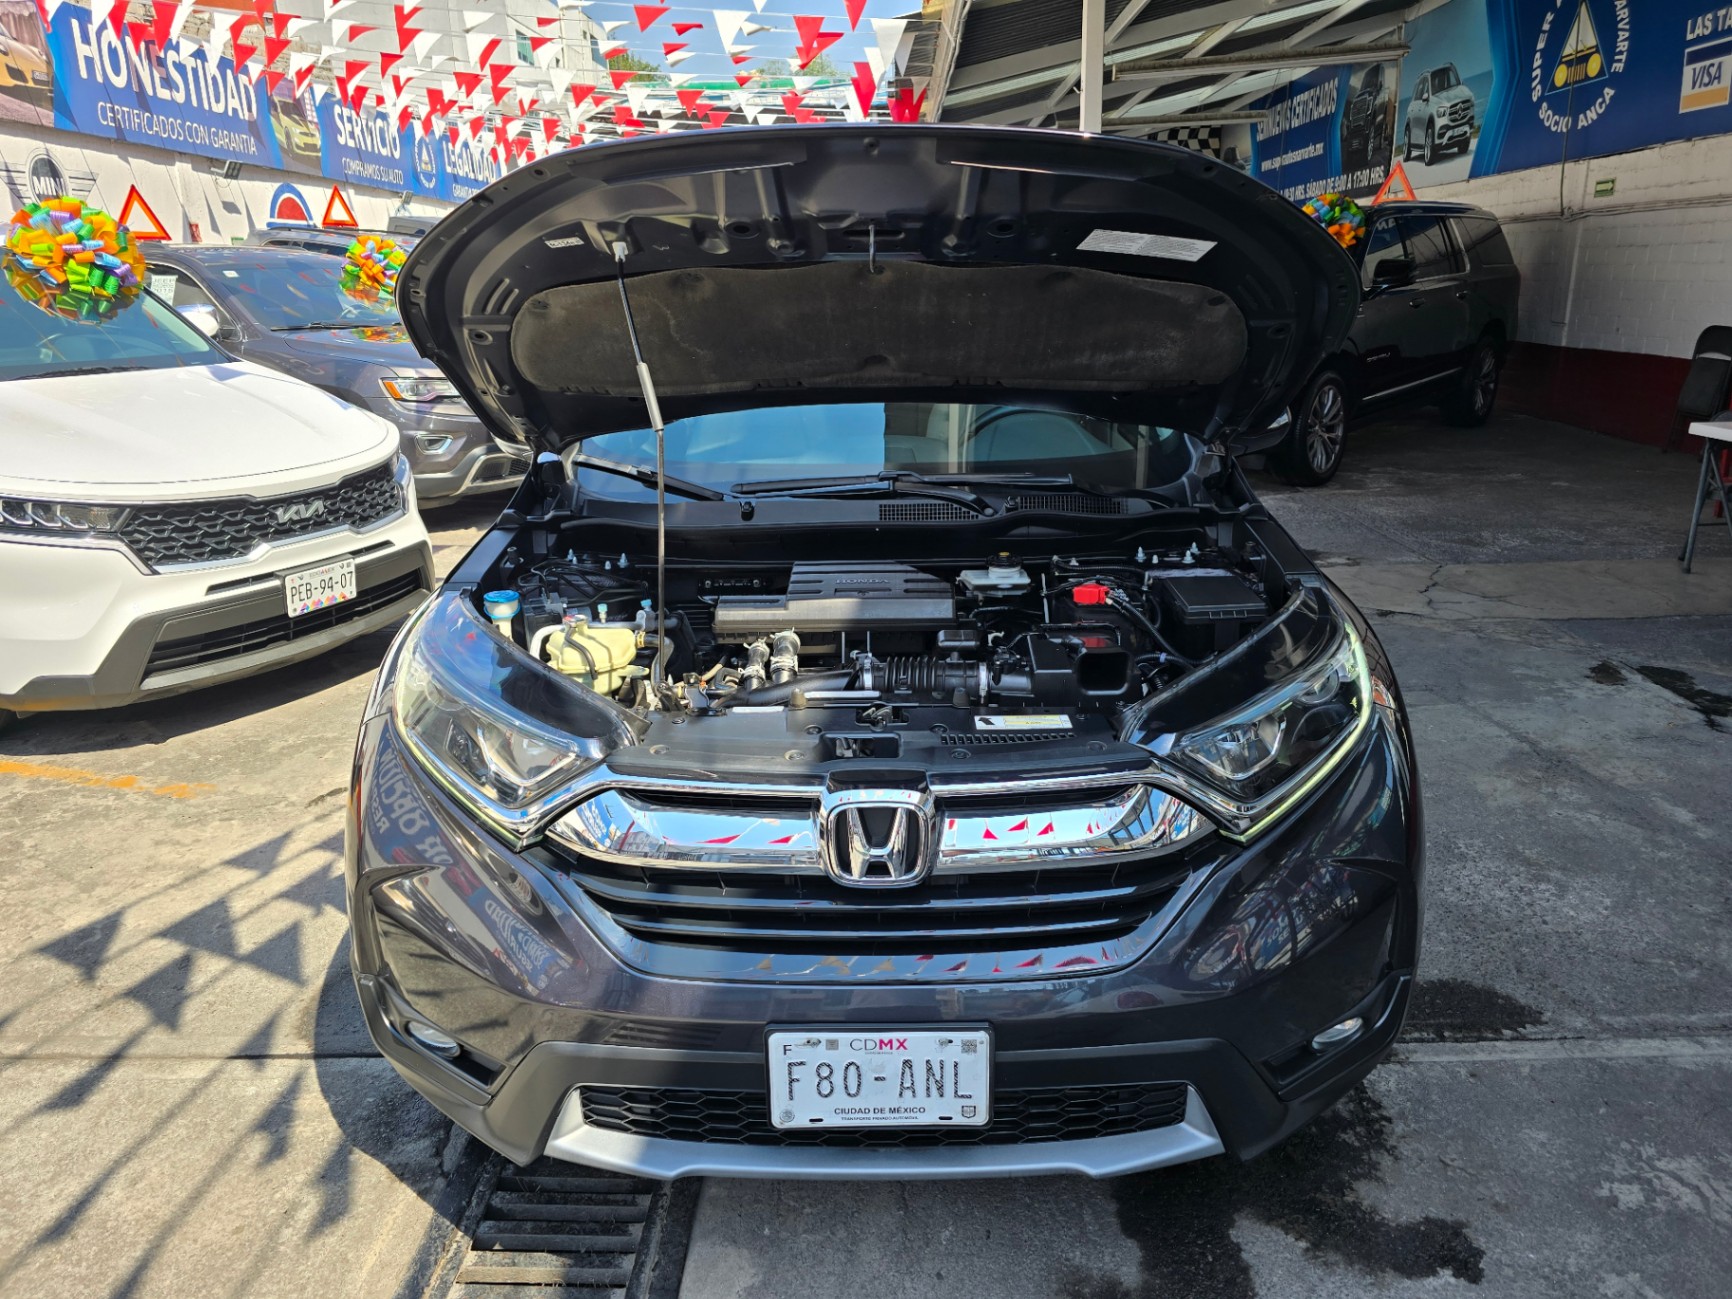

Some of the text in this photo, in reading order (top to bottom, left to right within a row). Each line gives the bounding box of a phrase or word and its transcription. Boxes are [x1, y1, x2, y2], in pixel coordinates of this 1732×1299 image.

[1610, 0, 1631, 73] ARVARTE
[1685, 14, 1713, 41] LAS
[71, 18, 257, 122] HONESTIDAD
[1531, 11, 1555, 102] SUPER
[1691, 61, 1723, 90] VISA
[1291, 77, 1338, 129] CERTIFICADOS
[1538, 86, 1616, 133] SOCIO ANCA
[97, 101, 258, 155] CERTIFICADOS CON GARANTIA
[334, 104, 401, 160] SERVICIO
[341, 156, 381, 181] COMPRAMOS
[442, 140, 496, 184] LEGALIDAD
[32, 175, 67, 196] MINI
[290, 570, 353, 605] PEB-94-07
[783, 1044, 792, 1056] F
[849, 1038, 909, 1051] CDMX
[787, 1058, 973, 1101] F80-ANL
[833, 1105, 926, 1115] CIUDAD DE MÉXICO
